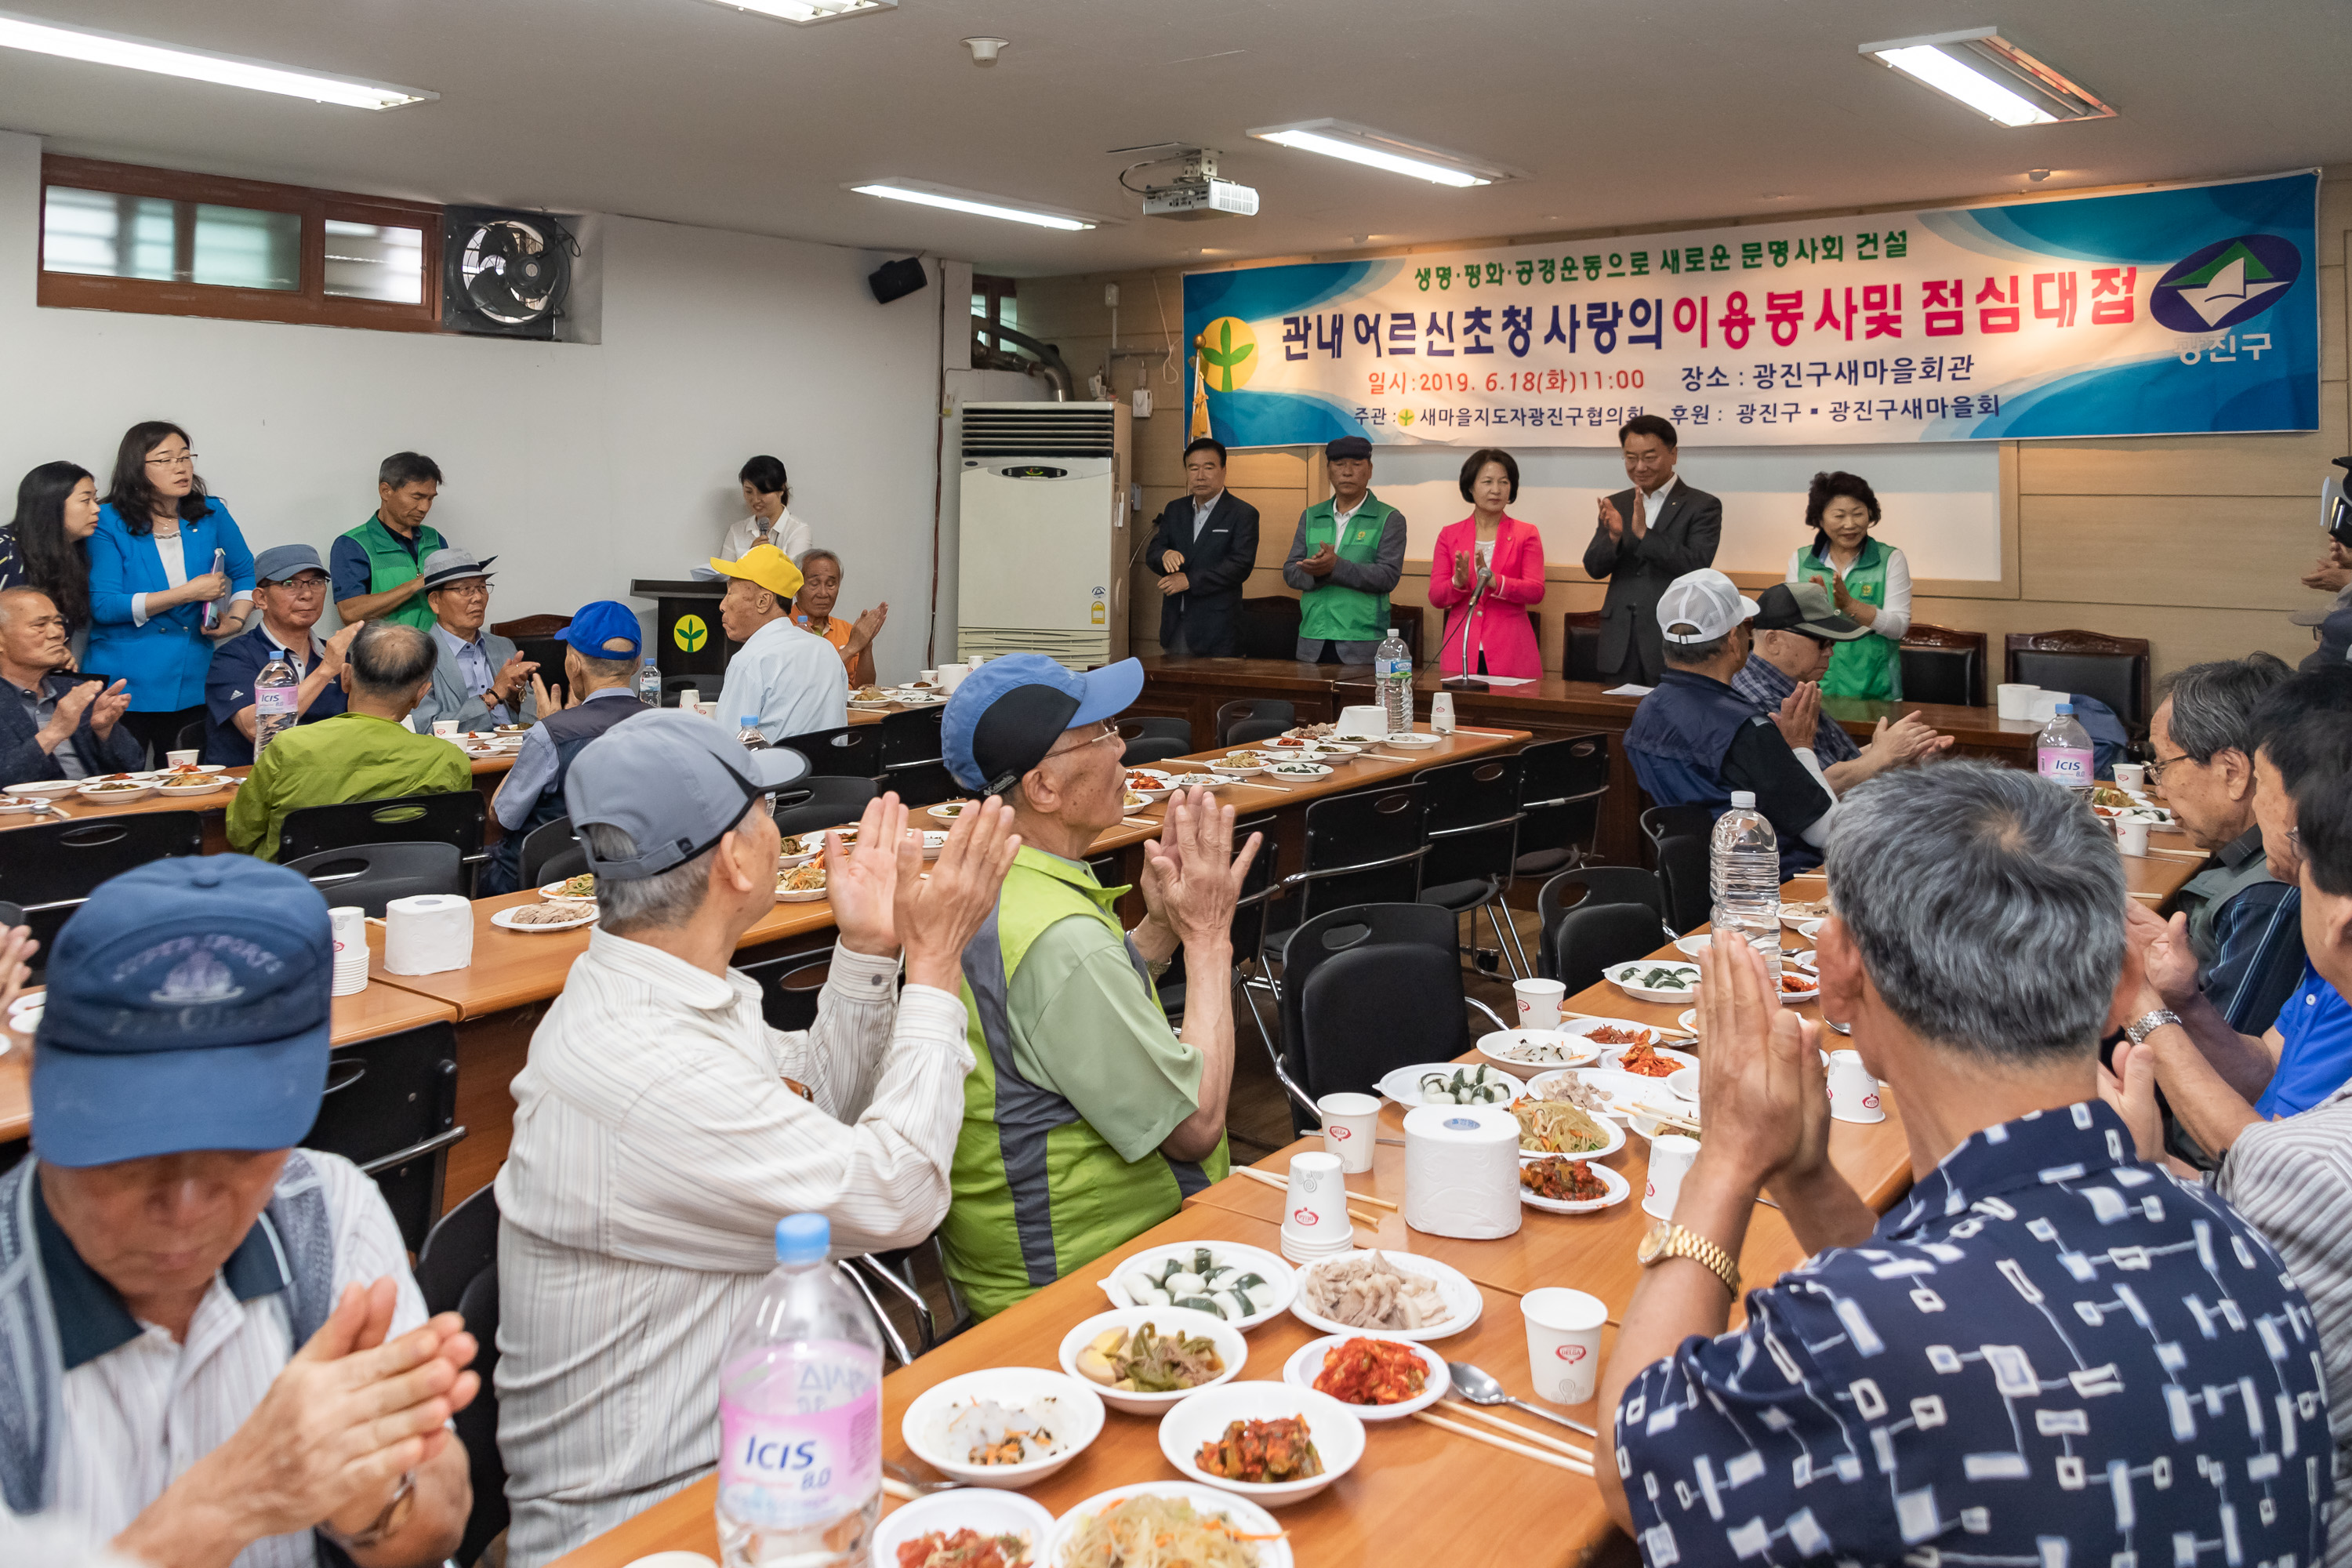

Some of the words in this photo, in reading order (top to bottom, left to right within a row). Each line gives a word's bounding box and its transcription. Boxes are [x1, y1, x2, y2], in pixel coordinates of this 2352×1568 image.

[1660, 244, 1730, 274] 새로운
[1741, 235, 1842, 269] 문명사회
[1856, 230, 1907, 260] 건설
[1751, 354, 1975, 390] 광진구새마을회관
[1736, 402, 1802, 424] 광진구
[1828, 394, 2000, 423] 광진구새마을회
[2056, 760, 2081, 770] ICIS
[745, 1435, 817, 1472] ICIS
